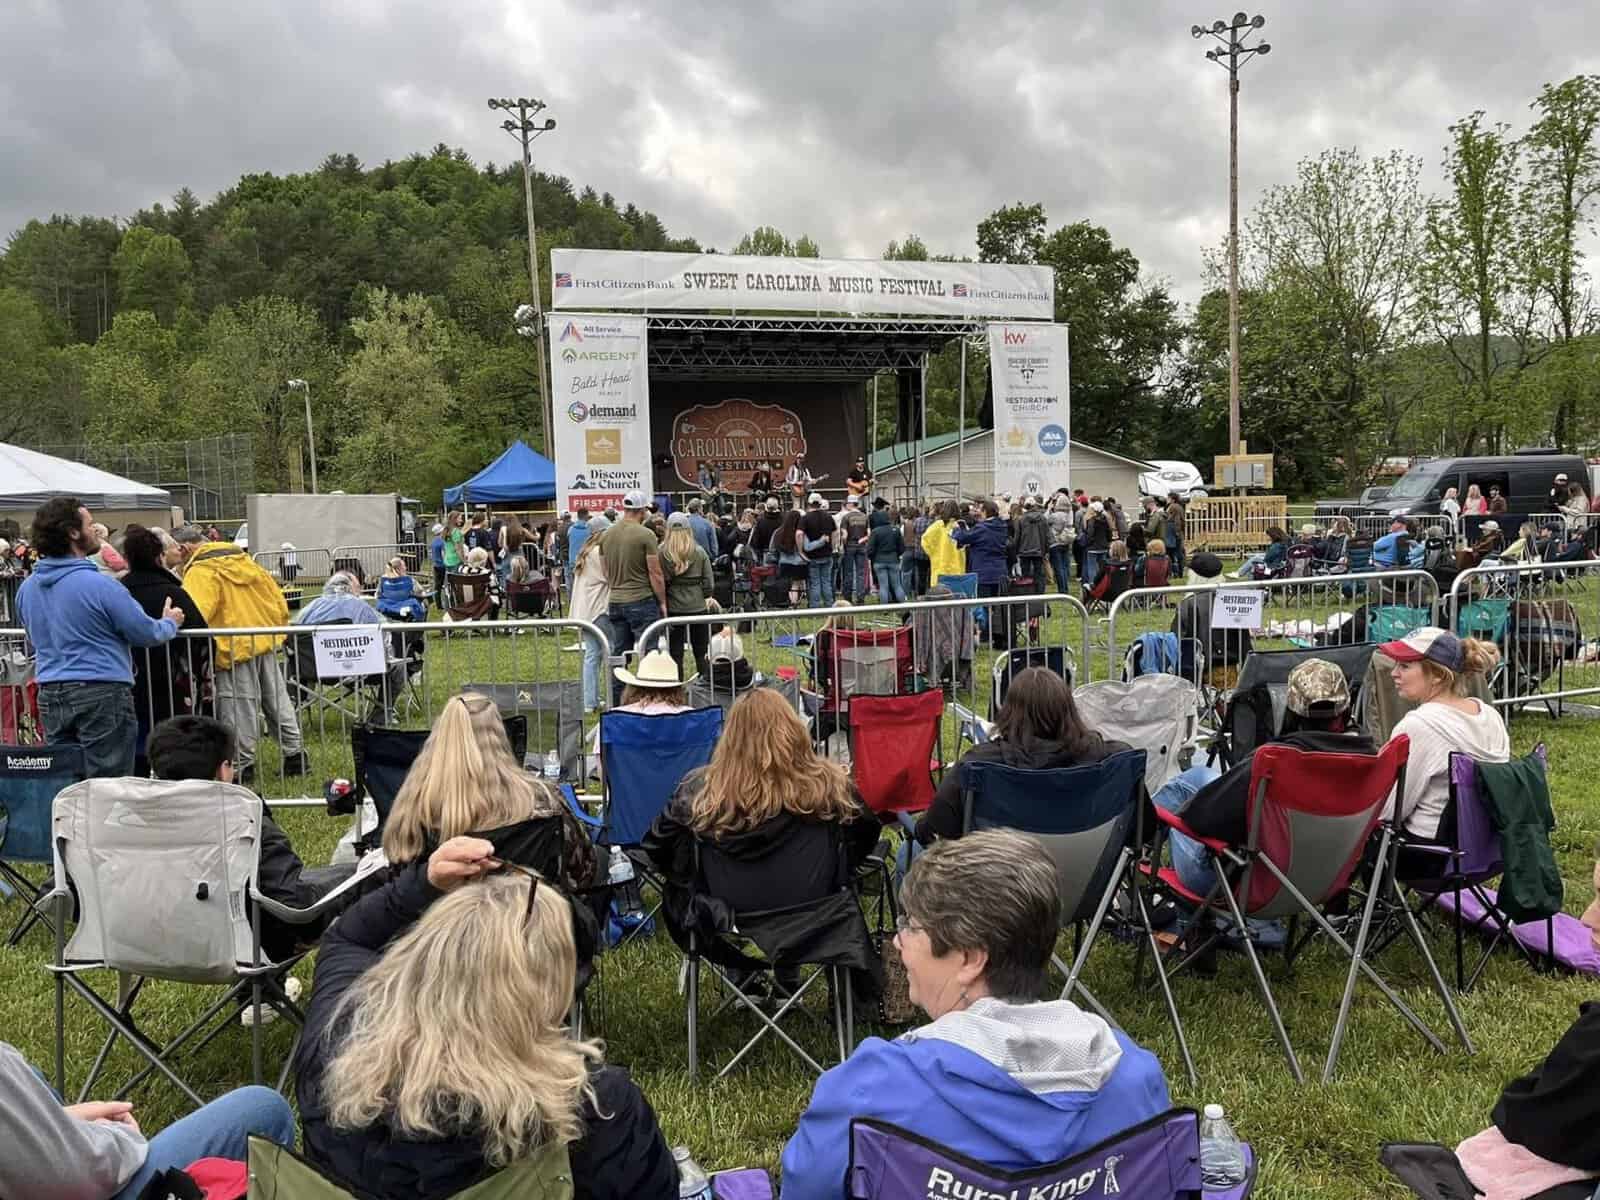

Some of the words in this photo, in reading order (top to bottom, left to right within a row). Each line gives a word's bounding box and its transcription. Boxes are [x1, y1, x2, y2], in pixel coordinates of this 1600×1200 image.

[683, 272, 739, 290] SWEET
[746, 273, 821, 292] CAROLINA
[829, 276, 873, 294] MUSIC
[880, 278, 946, 296] FESTIVAL
[1004, 327, 1027, 344] kw
[579, 351, 637, 360] ARGENT
[570, 376, 598, 394] Bald
[600, 370, 631, 389] Head
[589, 403, 636, 417] demand
[1012, 404, 1048, 412] CHURCH
[678, 438, 748, 457] CAROLINA
[755, 437, 798, 457] MUSIC
[590, 469, 640, 479] Discover
[598, 480, 641, 489] Church
[1028, 482, 1038, 493] W
[573, 500, 603, 508] FIRST
[1223, 595, 1256, 604] RESTRICTED
[323, 636, 370, 648] RESTRICTED
[344, 648, 362, 658] AREA
[7, 756, 53, 769] Academy
[927, 1166, 1018, 1200] Rural
[1028, 1168, 1099, 1200] King
